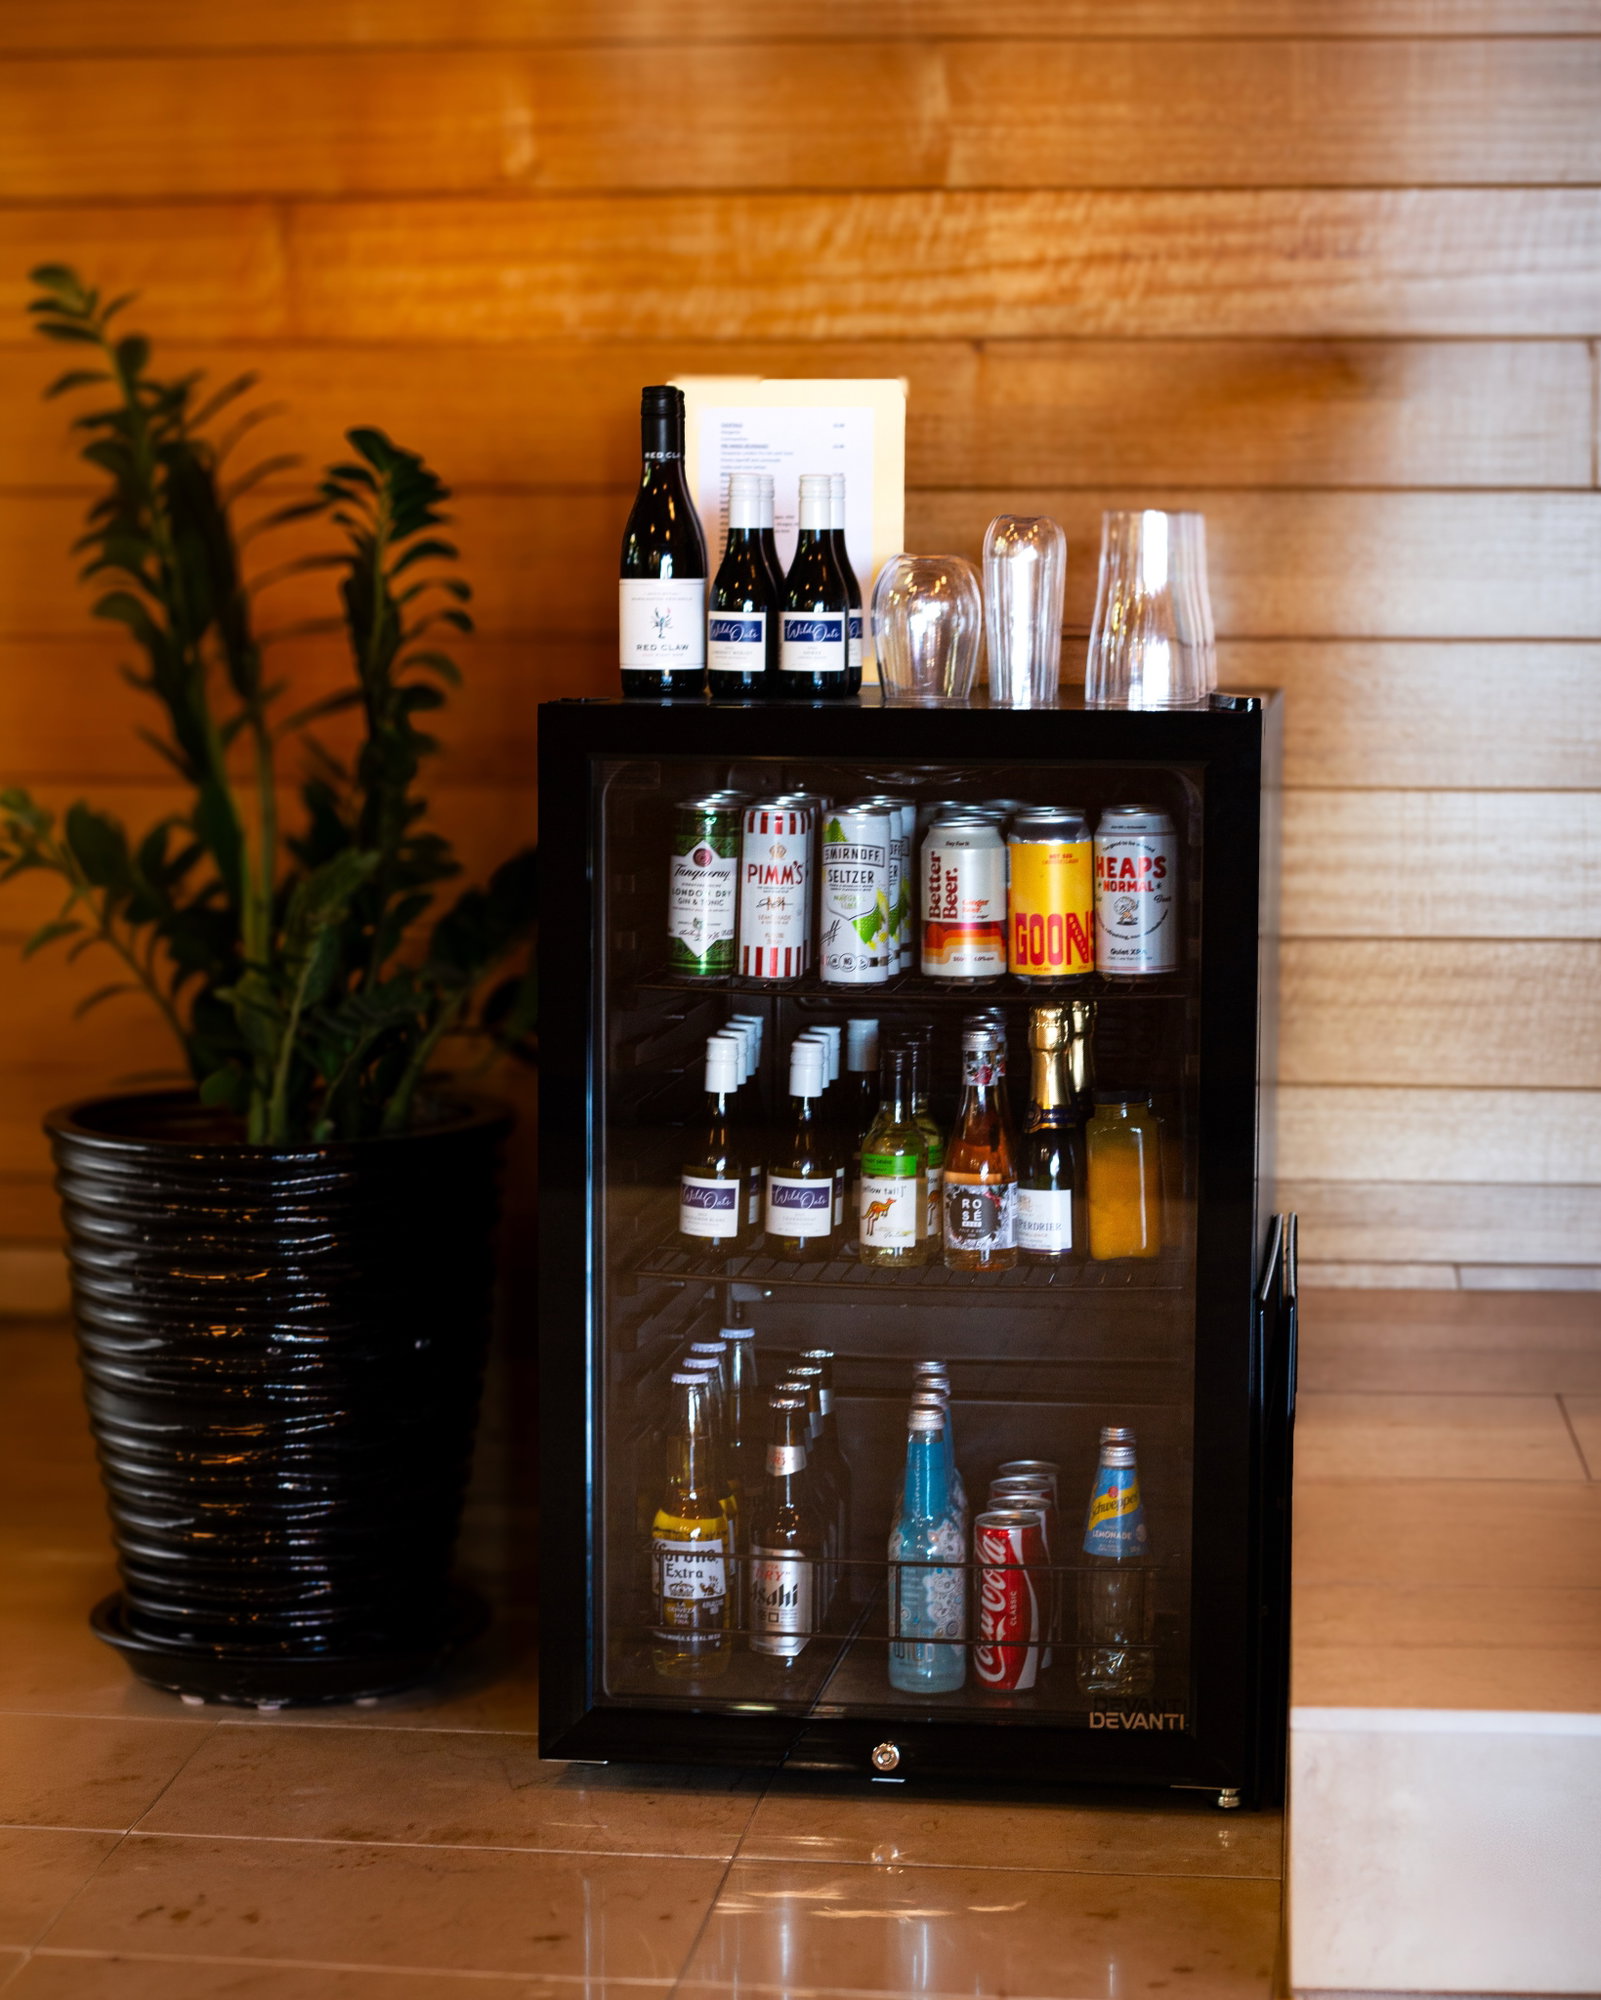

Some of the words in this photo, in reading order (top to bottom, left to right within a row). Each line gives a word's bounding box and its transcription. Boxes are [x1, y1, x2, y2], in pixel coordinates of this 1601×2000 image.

[785, 620, 814, 639] Wild
[813, 623, 840, 643] Oats
[636, 643, 657, 651] RED
[661, 643, 689, 651] CLAW
[825, 847, 881, 863] SMIRNOFF
[674, 863, 731, 881] Tanqueray
[747, 860, 803, 885] PIMM'S
[828, 869, 874, 884] SELTZER
[1096, 856, 1167, 879] HEAPS
[716, 890, 732, 898] DRY
[929, 851, 942, 919] Better
[1103, 880, 1154, 892] NORMAL
[774, 1185, 802, 1204] Wild
[800, 1190, 826, 1210] Oats
[1092, 1529, 1132, 1541] LEMONADE
[666, 1563, 704, 1579] Extra
[750, 1580, 799, 1608] Asahi
[1089, 1711, 1185, 1730] DEVANTI
